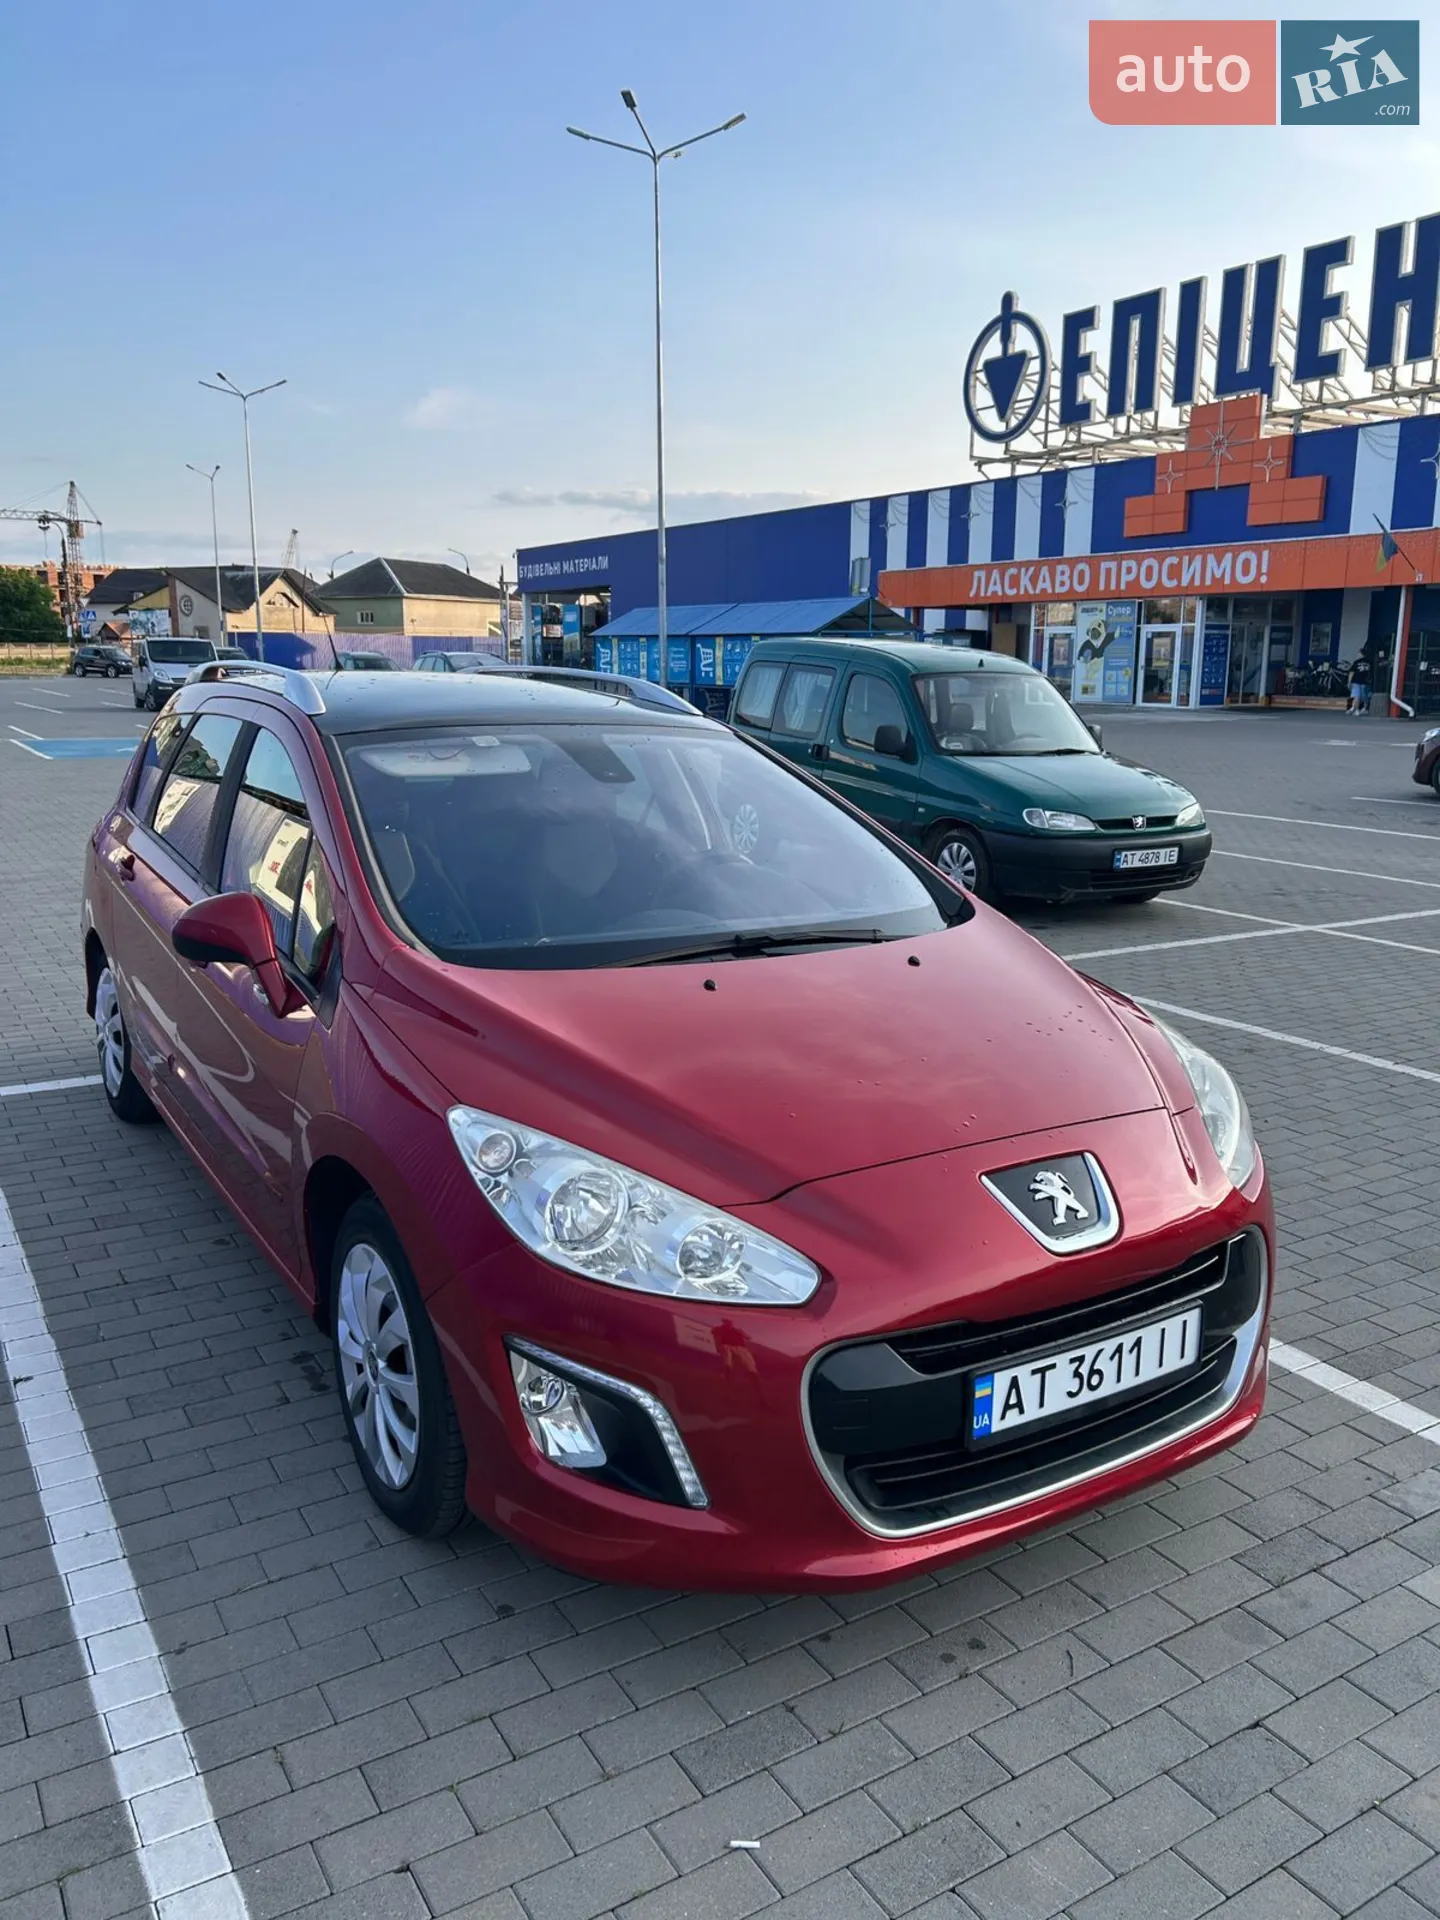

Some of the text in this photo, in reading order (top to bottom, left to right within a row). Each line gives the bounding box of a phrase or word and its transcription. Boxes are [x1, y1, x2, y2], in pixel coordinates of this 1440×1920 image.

[519, 555, 609, 579] БУДІВЕЛЬНІ МАТЕРІАЛИ
[969, 549, 1270, 598] ЛАСКАВО ПРОСИМО!
[1107, 605, 1132, 617] Супер
[1121, 853, 1137, 866] AT
[1138, 851, 1160, 864] 4878
[1163, 850, 1176, 862] IE
[999, 1362, 1057, 1421] AT
[1065, 1335, 1144, 1399] 3611
[973, 1415, 991, 1430] UA
